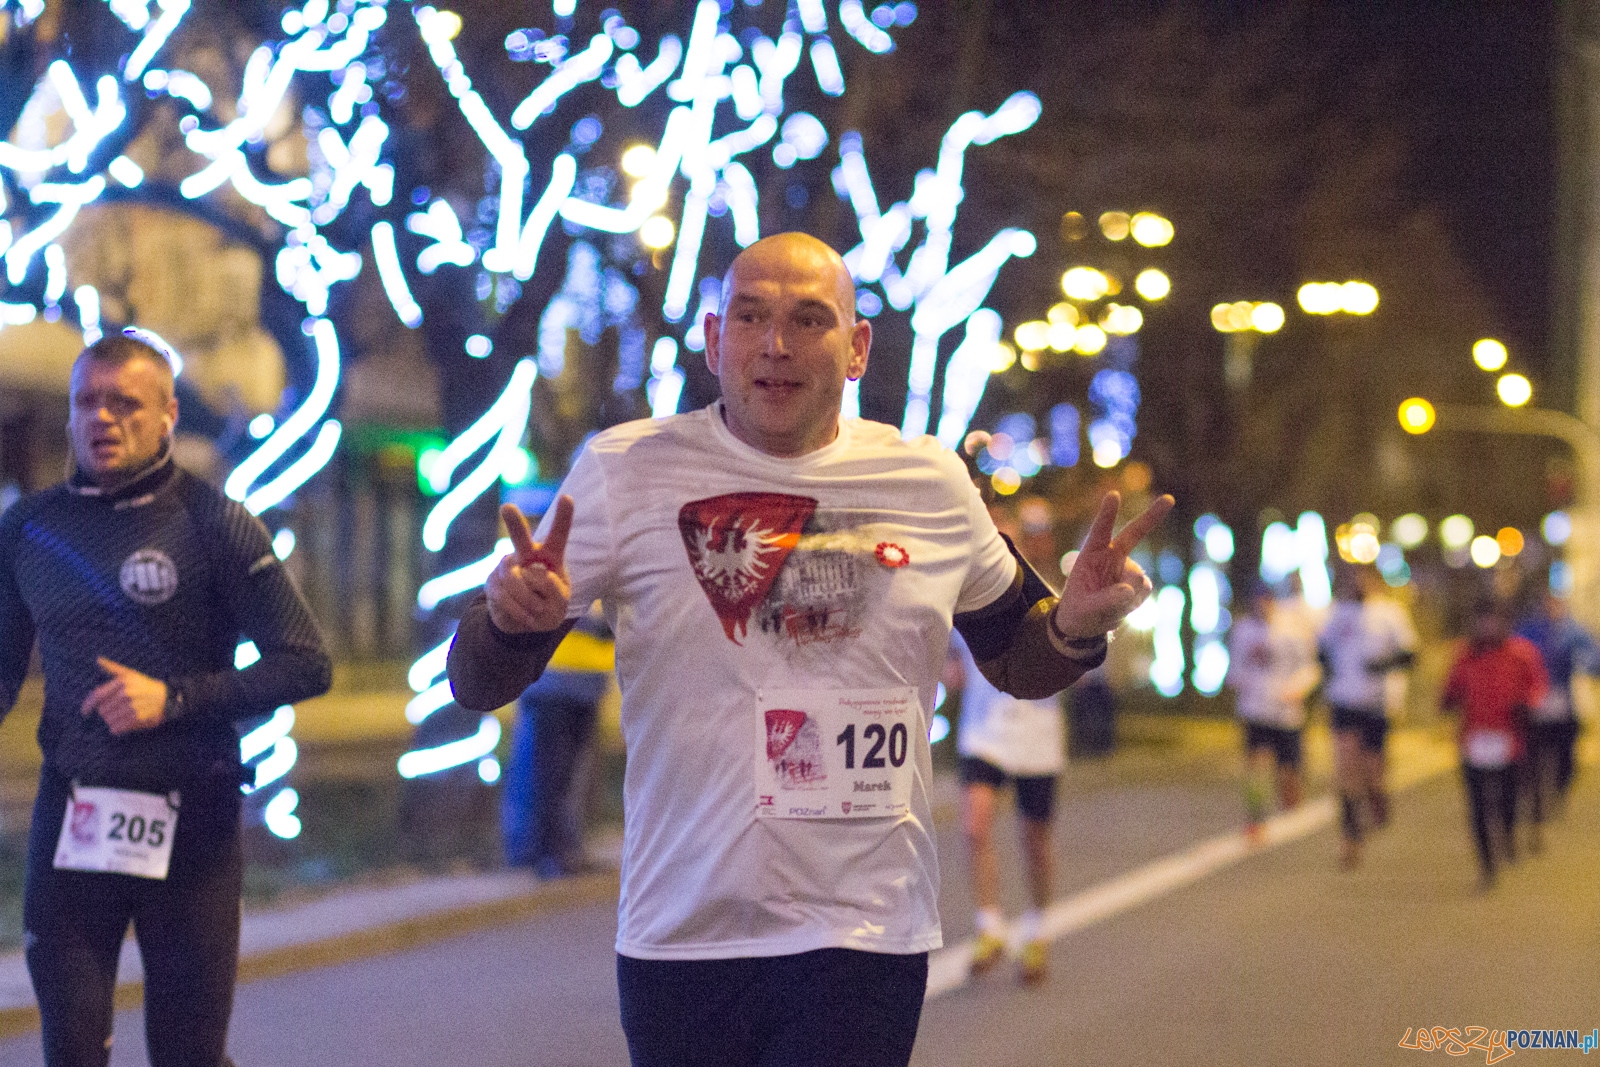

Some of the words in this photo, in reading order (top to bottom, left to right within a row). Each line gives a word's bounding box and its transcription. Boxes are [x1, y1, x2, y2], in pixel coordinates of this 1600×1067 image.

[836, 723, 908, 769] 120
[852, 781, 892, 793] Marek
[107, 812, 166, 848] 205
